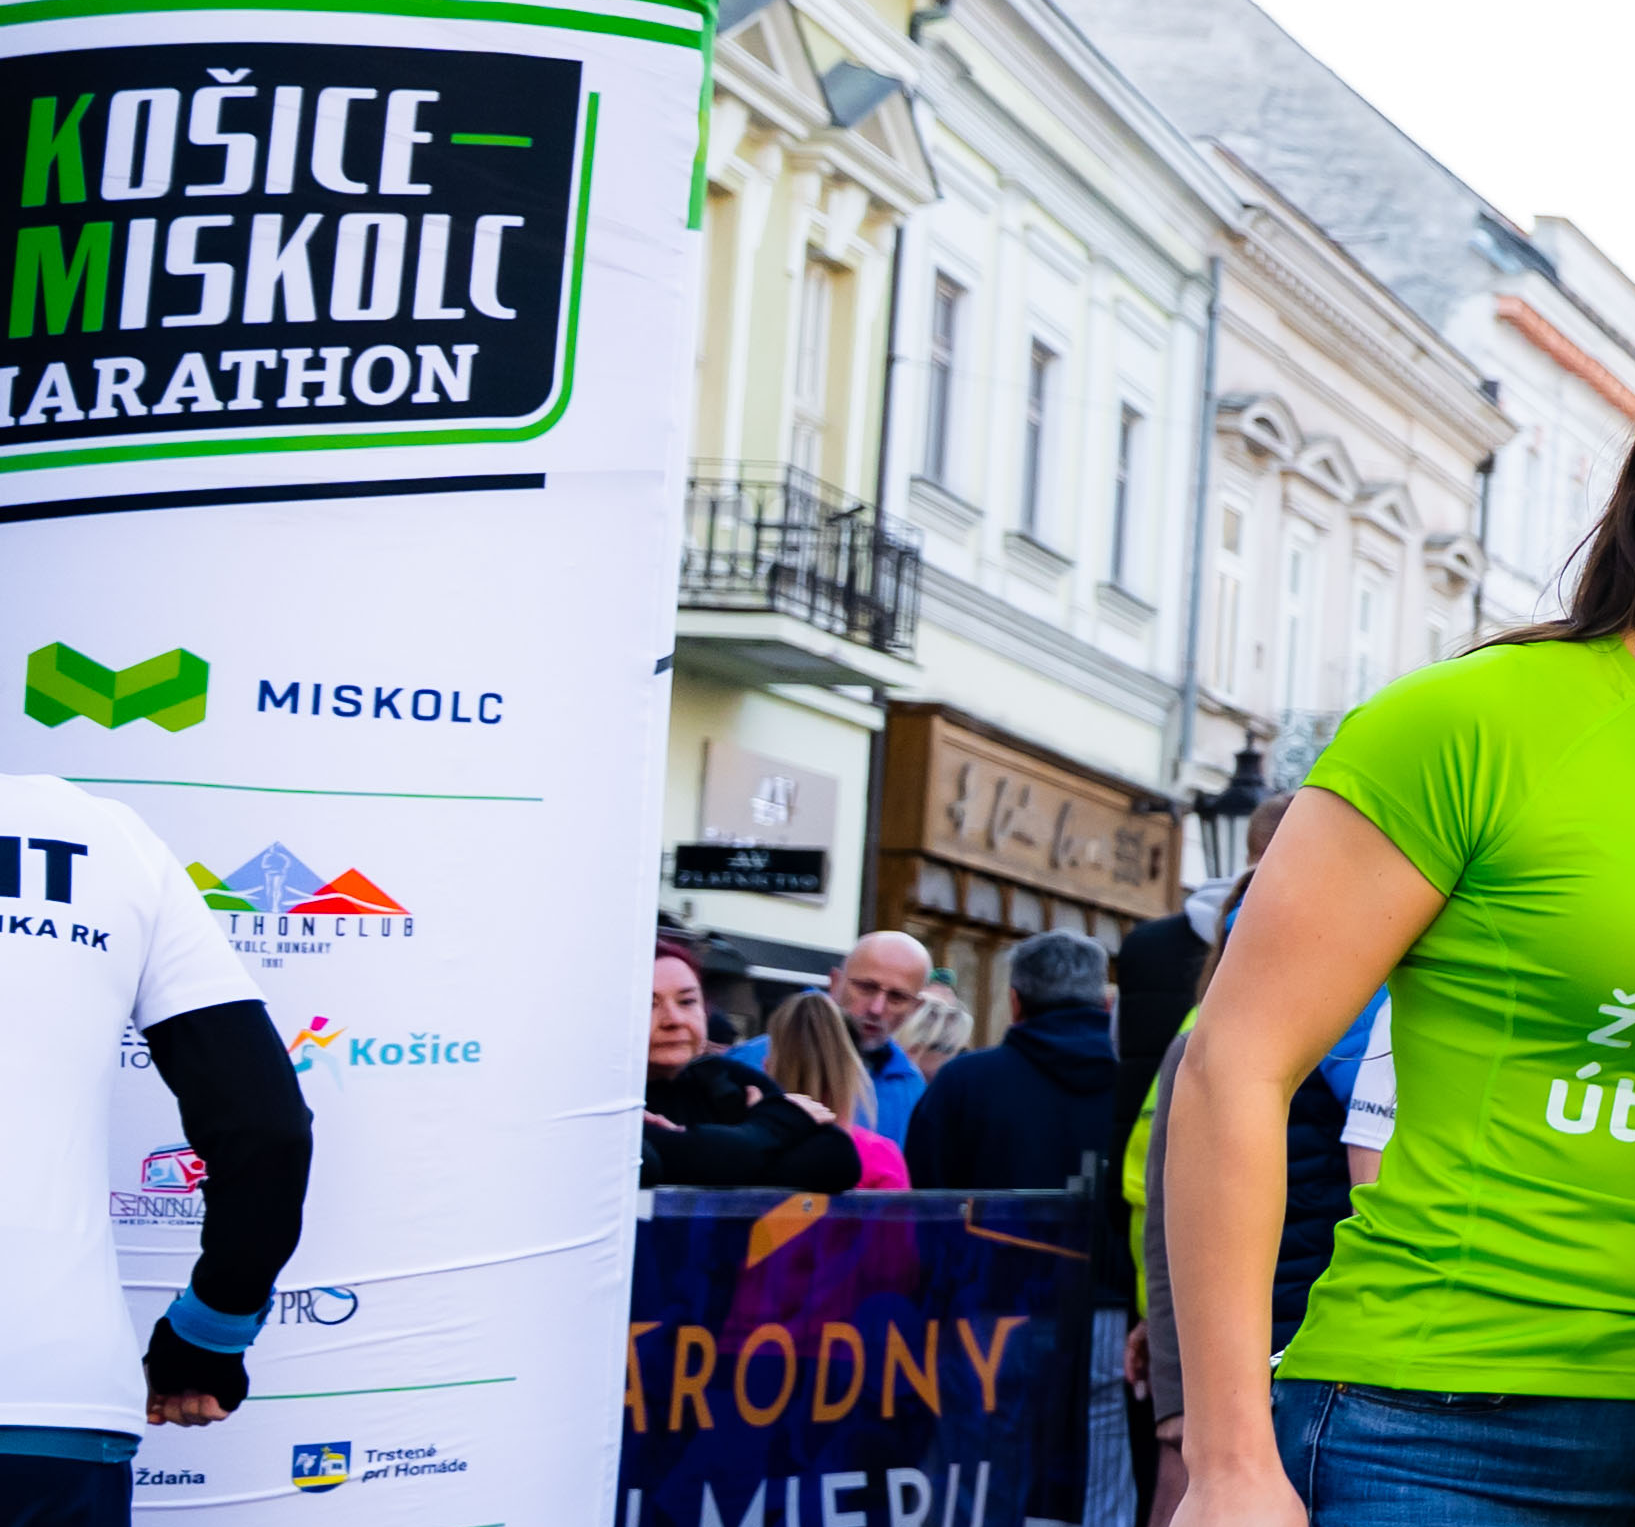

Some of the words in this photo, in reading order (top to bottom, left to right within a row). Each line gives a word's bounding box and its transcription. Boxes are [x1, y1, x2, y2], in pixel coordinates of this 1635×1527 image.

[7, 212, 525, 339] MISKOLC
[257, 679, 503, 725] MISKOLC
[230, 914, 315, 937] THON
[335, 917, 414, 937] CLUB
[71, 923, 111, 952] RK
[277, 942, 331, 955] HUNGARY
[348, 1033, 483, 1067] Košice
[365, 1443, 437, 1463] Trstené
[135, 1467, 205, 1486] Ždaňa
[362, 1467, 391, 1483] pri
